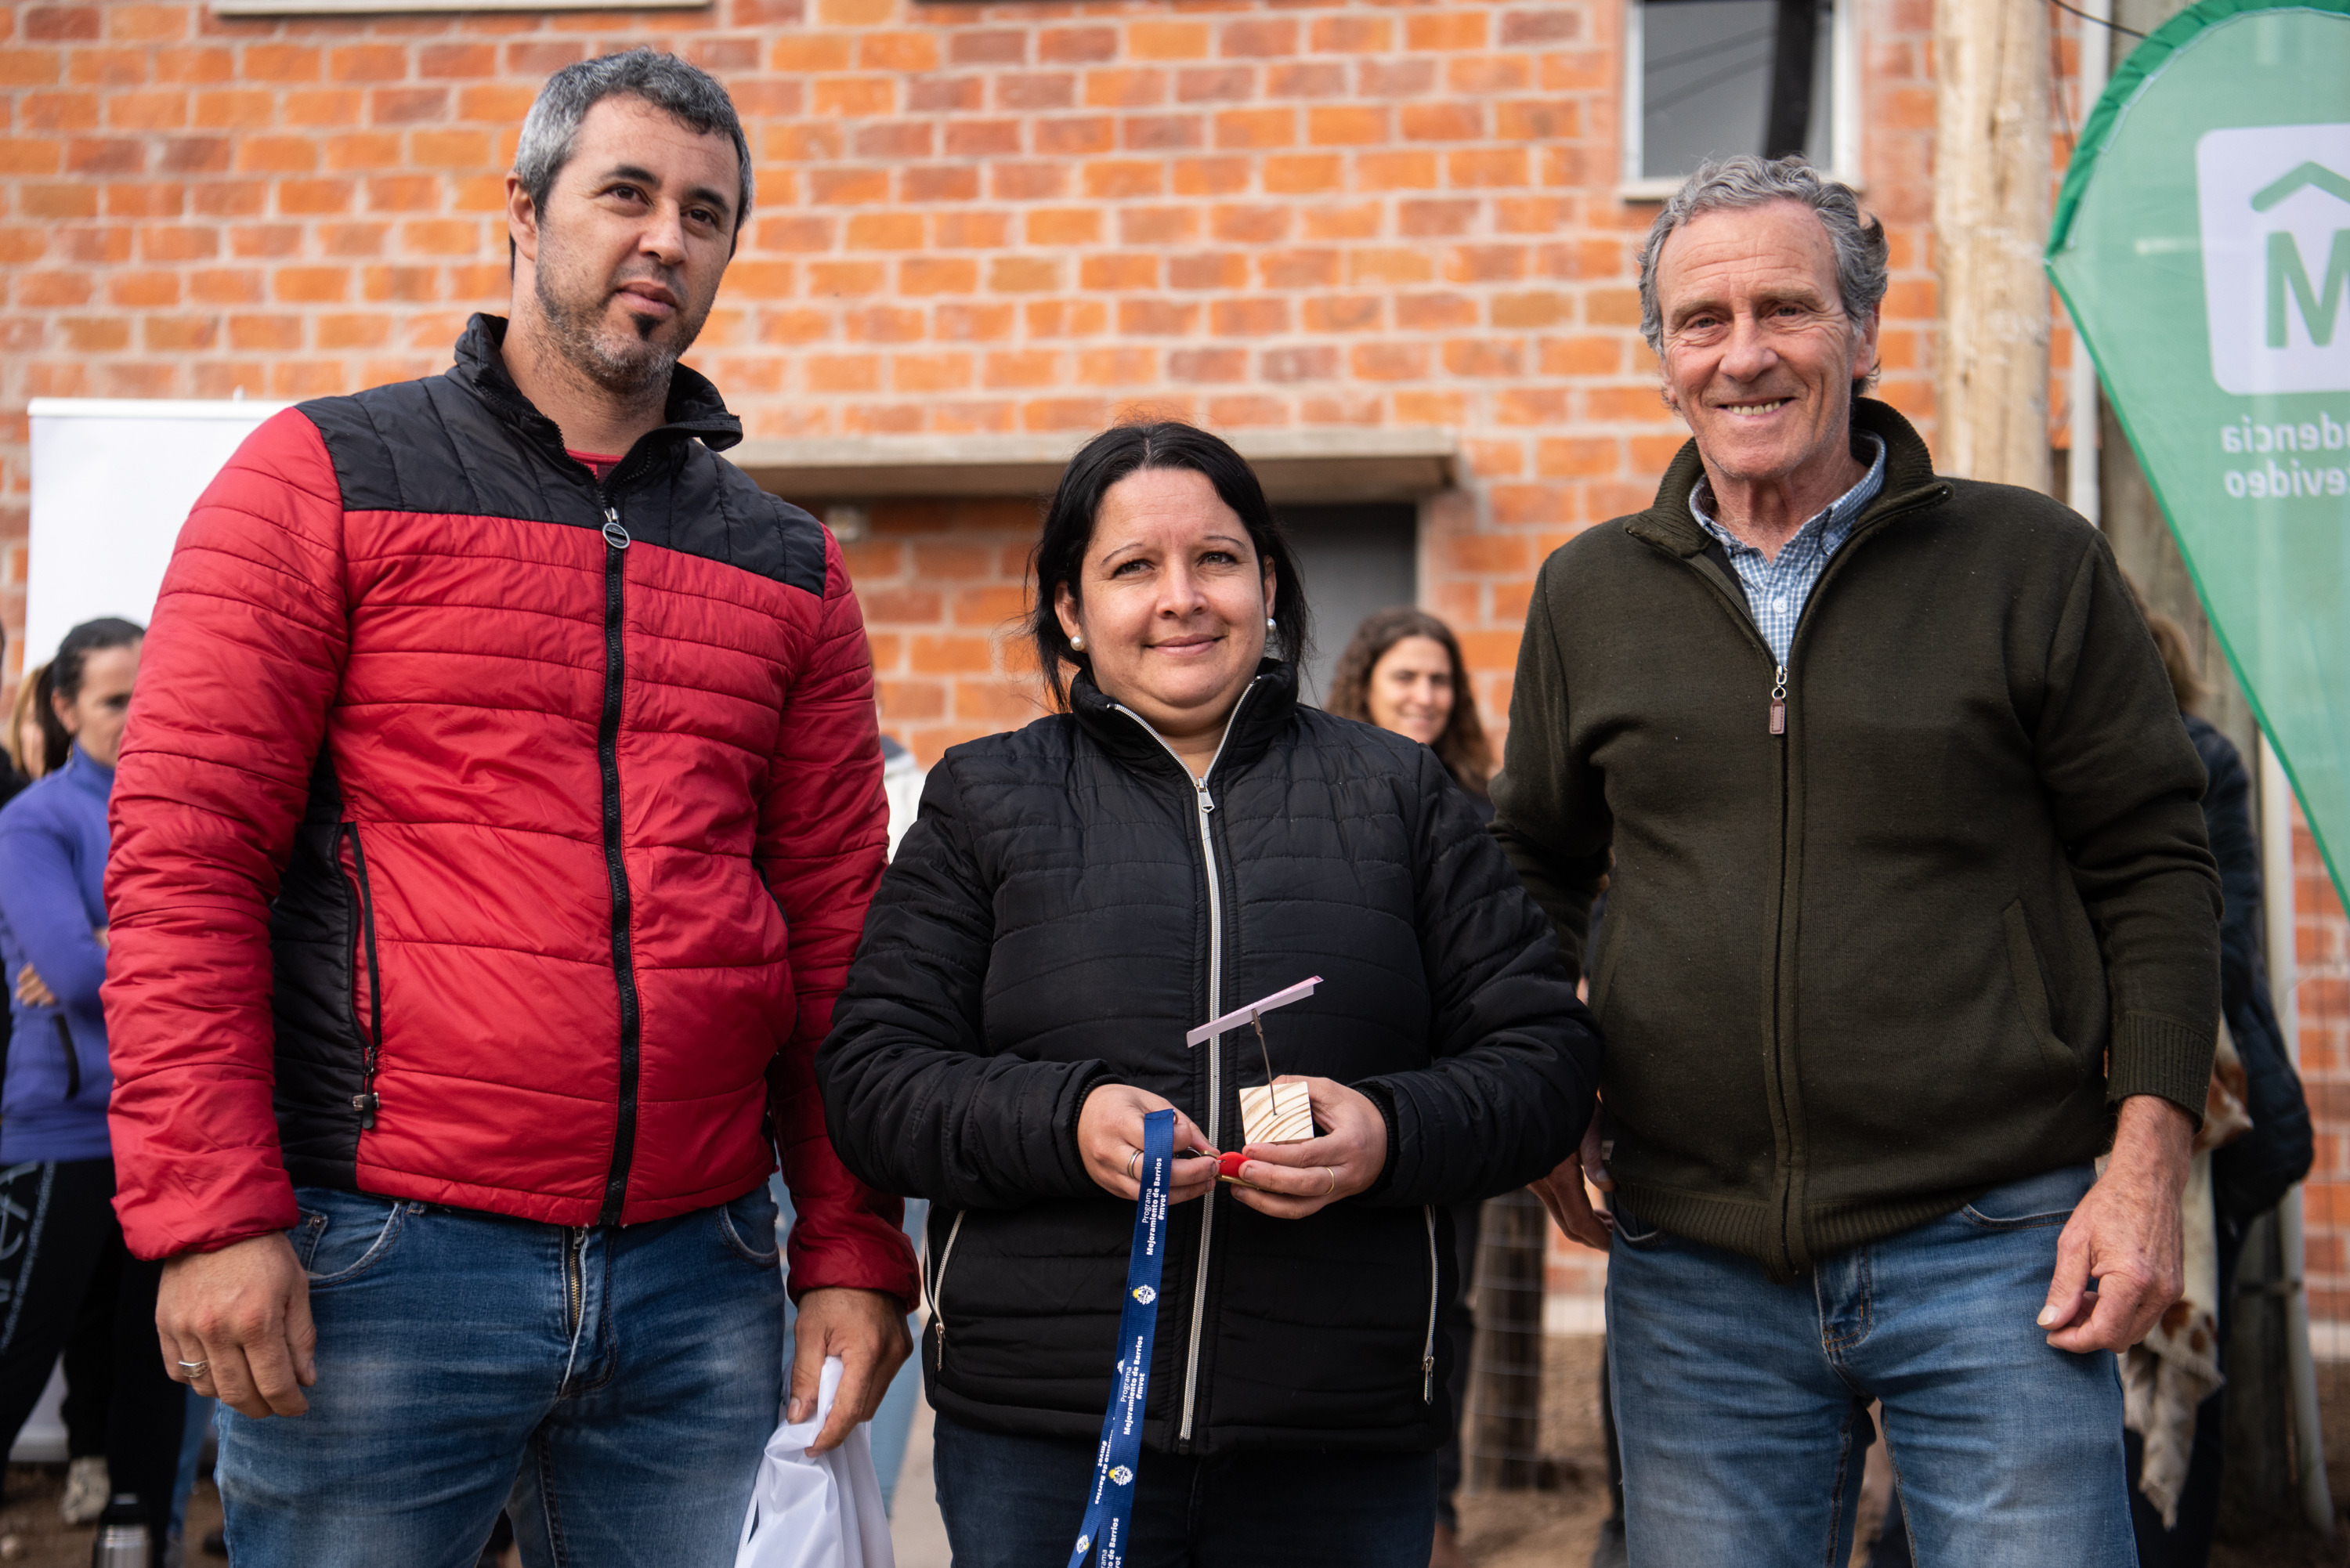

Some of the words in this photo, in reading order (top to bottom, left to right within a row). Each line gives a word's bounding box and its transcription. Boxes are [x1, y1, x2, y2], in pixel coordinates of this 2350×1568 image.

[1153, 1158, 1162, 1187] Barrios
[1141, 1188, 1152, 1223] Programa
[1152, 1187, 1160, 1198] de
[1157, 1194, 1166, 1220] #mvot
[1146, 1199, 1159, 1255] Mejoramiento
[1133, 1335, 1144, 1365] Barrios
[1120, 1367, 1132, 1403] Programa
[1132, 1366, 1139, 1377] de
[1135, 1372, 1145, 1400] #mvot
[1123, 1378, 1137, 1436] Mejoramiento
[1097, 1440, 1108, 1467] #mvot
[1101, 1464, 1108, 1474] de
[1094, 1475, 1106, 1505] Barrios
[1108, 1517, 1119, 1548] Barrios
[1108, 1549, 1115, 1560] de
